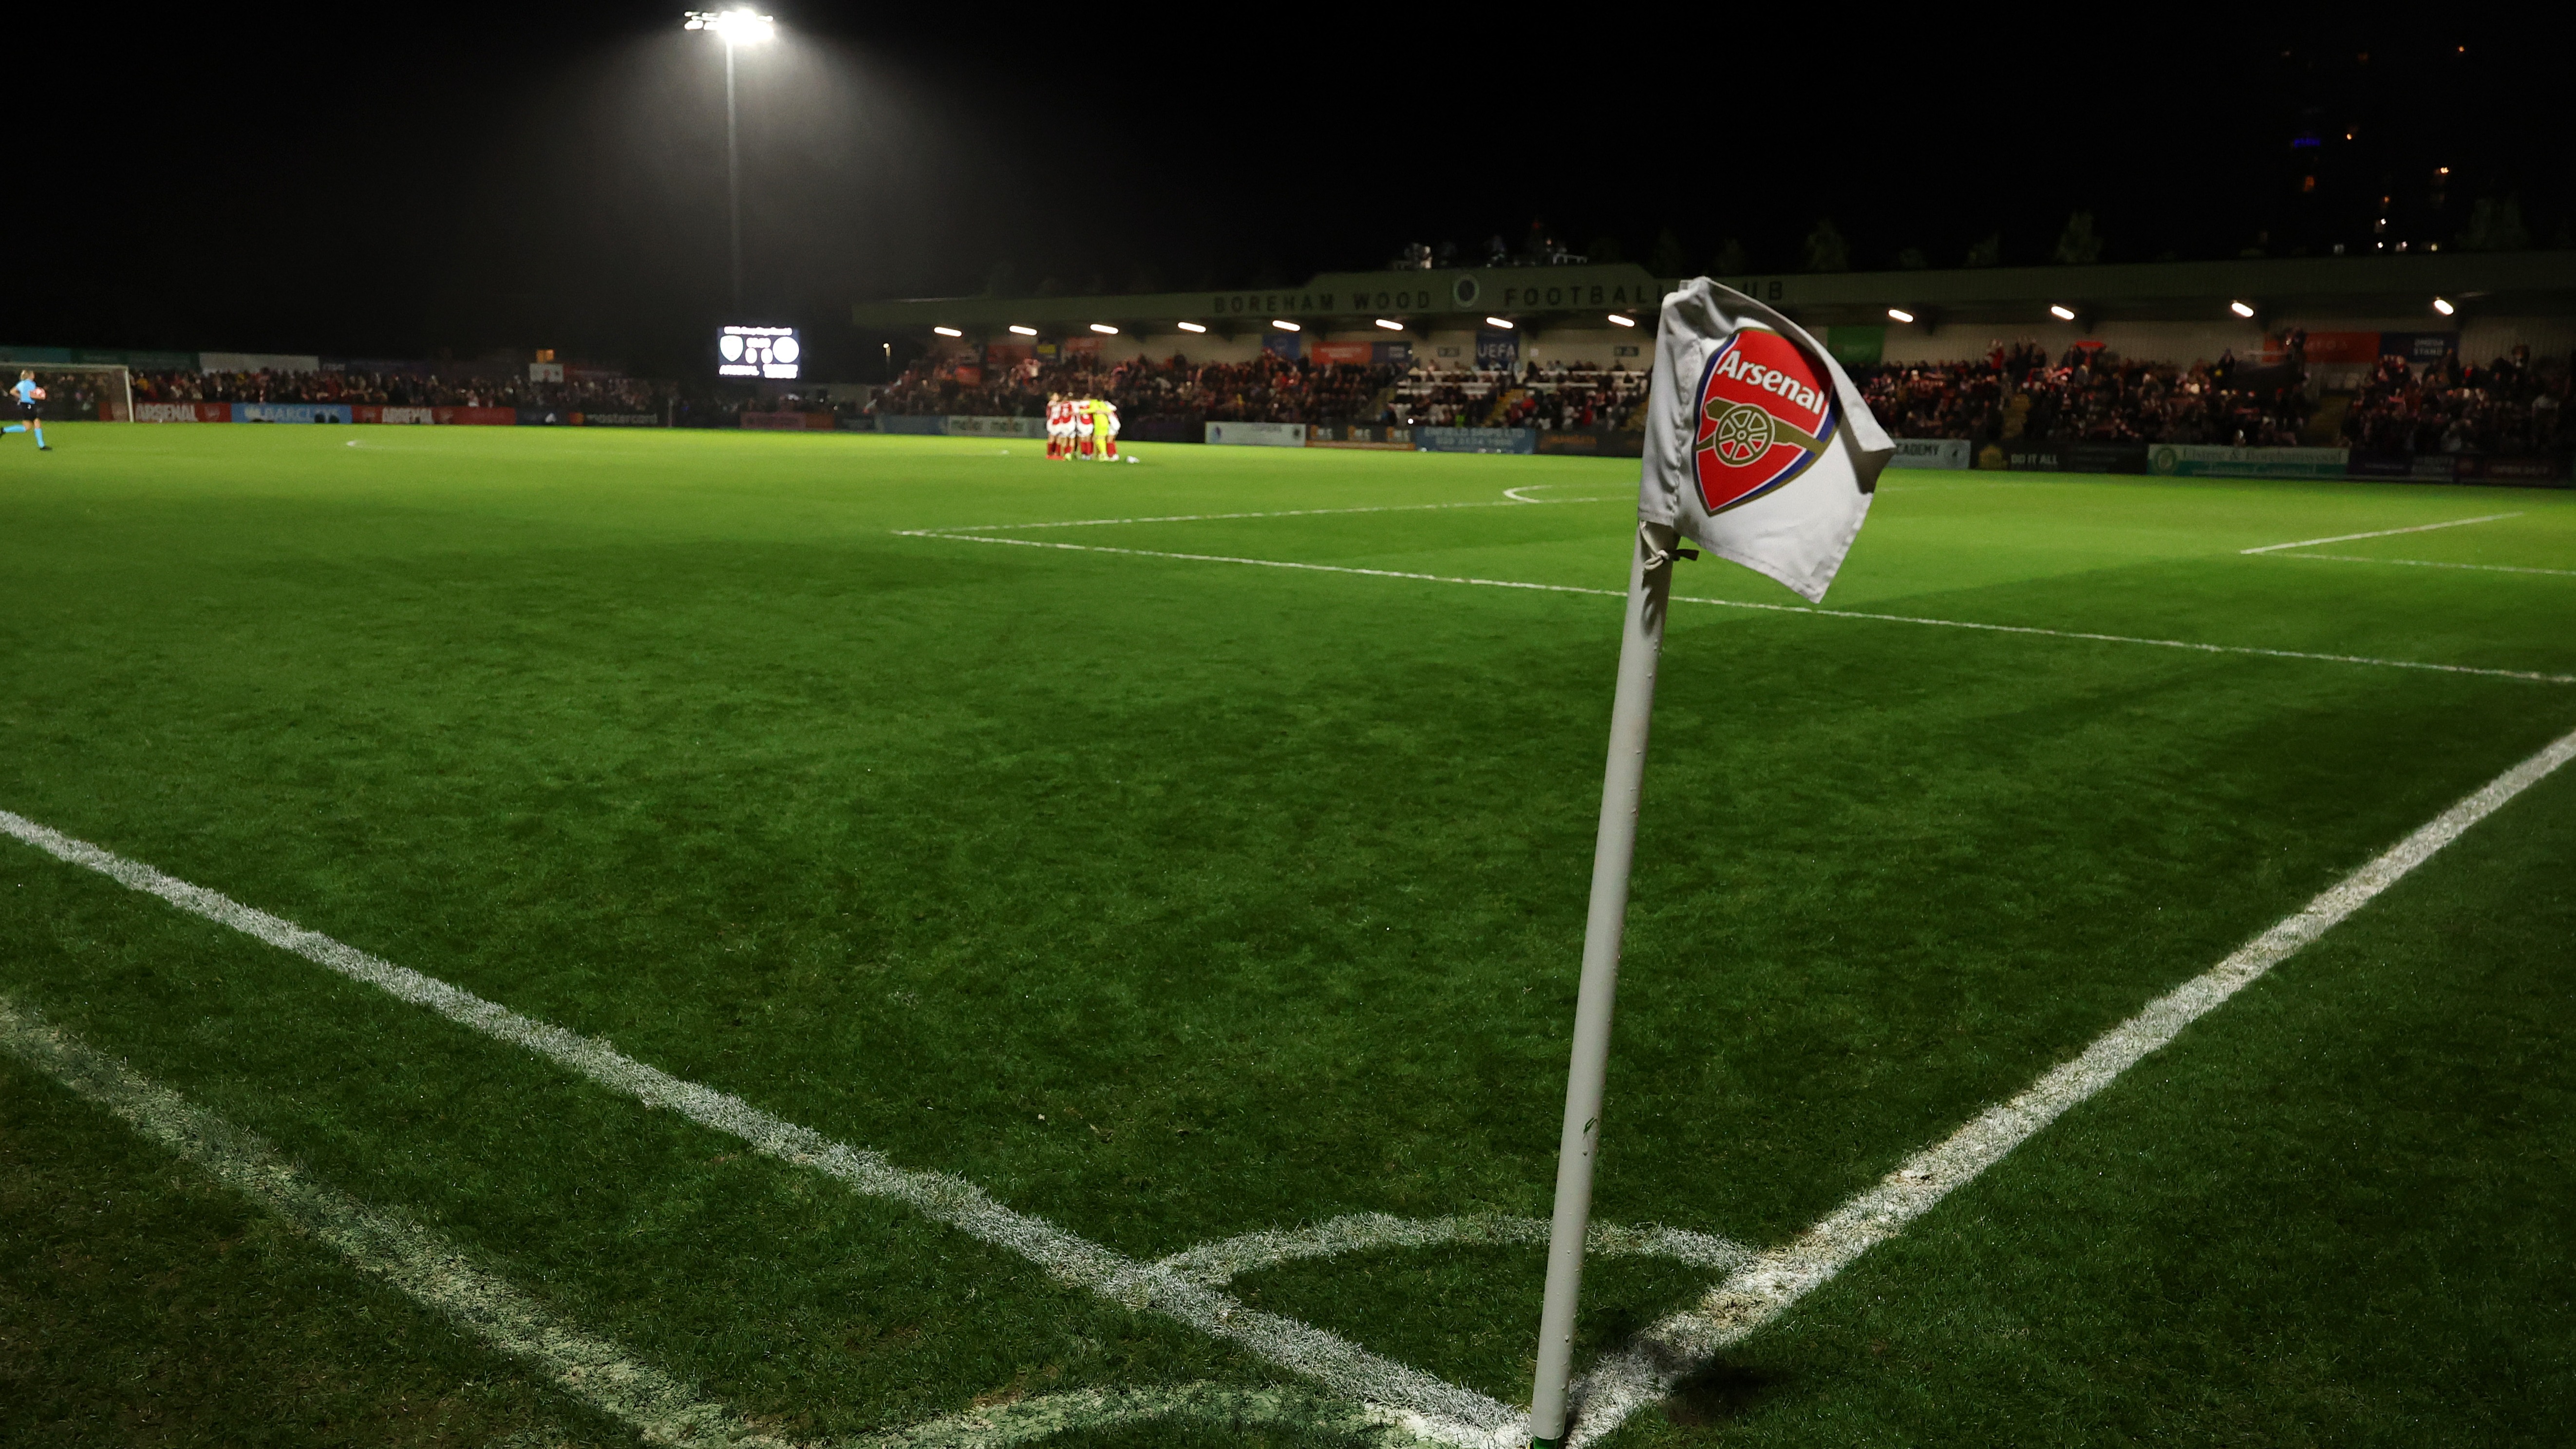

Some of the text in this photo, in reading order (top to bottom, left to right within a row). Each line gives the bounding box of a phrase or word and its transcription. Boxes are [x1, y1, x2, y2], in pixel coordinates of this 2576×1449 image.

[1214, 294, 1334, 313] BOREHAM
[1353, 291, 1430, 311] WOOD
[1742, 282, 1783, 300] UB
[1477, 343, 1515, 357] UEFA
[1716, 349, 1825, 415] Arsenal
